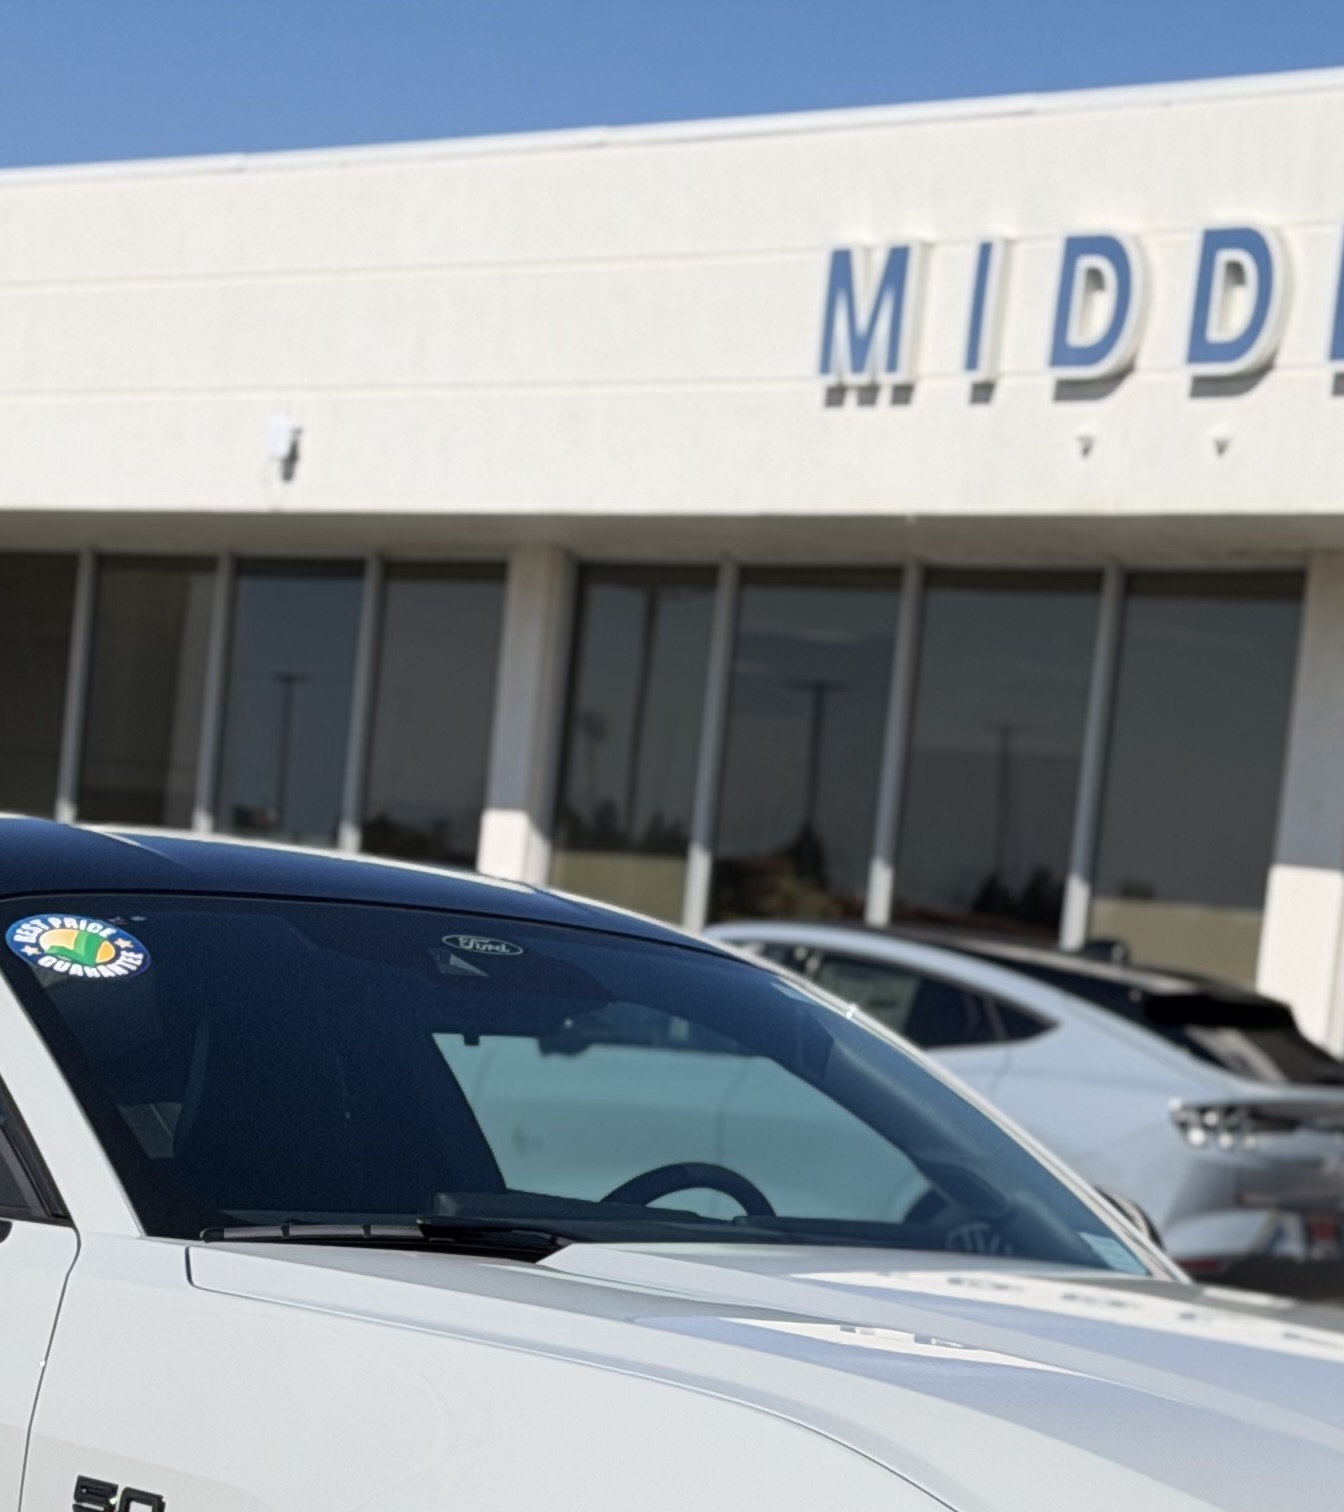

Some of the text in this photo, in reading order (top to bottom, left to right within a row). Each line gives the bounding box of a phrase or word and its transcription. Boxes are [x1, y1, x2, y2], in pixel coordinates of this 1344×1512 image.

[13, 915, 118, 944] BEST PRICE
[457, 936, 511, 954] Ford
[36, 949, 146, 979] GUARANTEE
